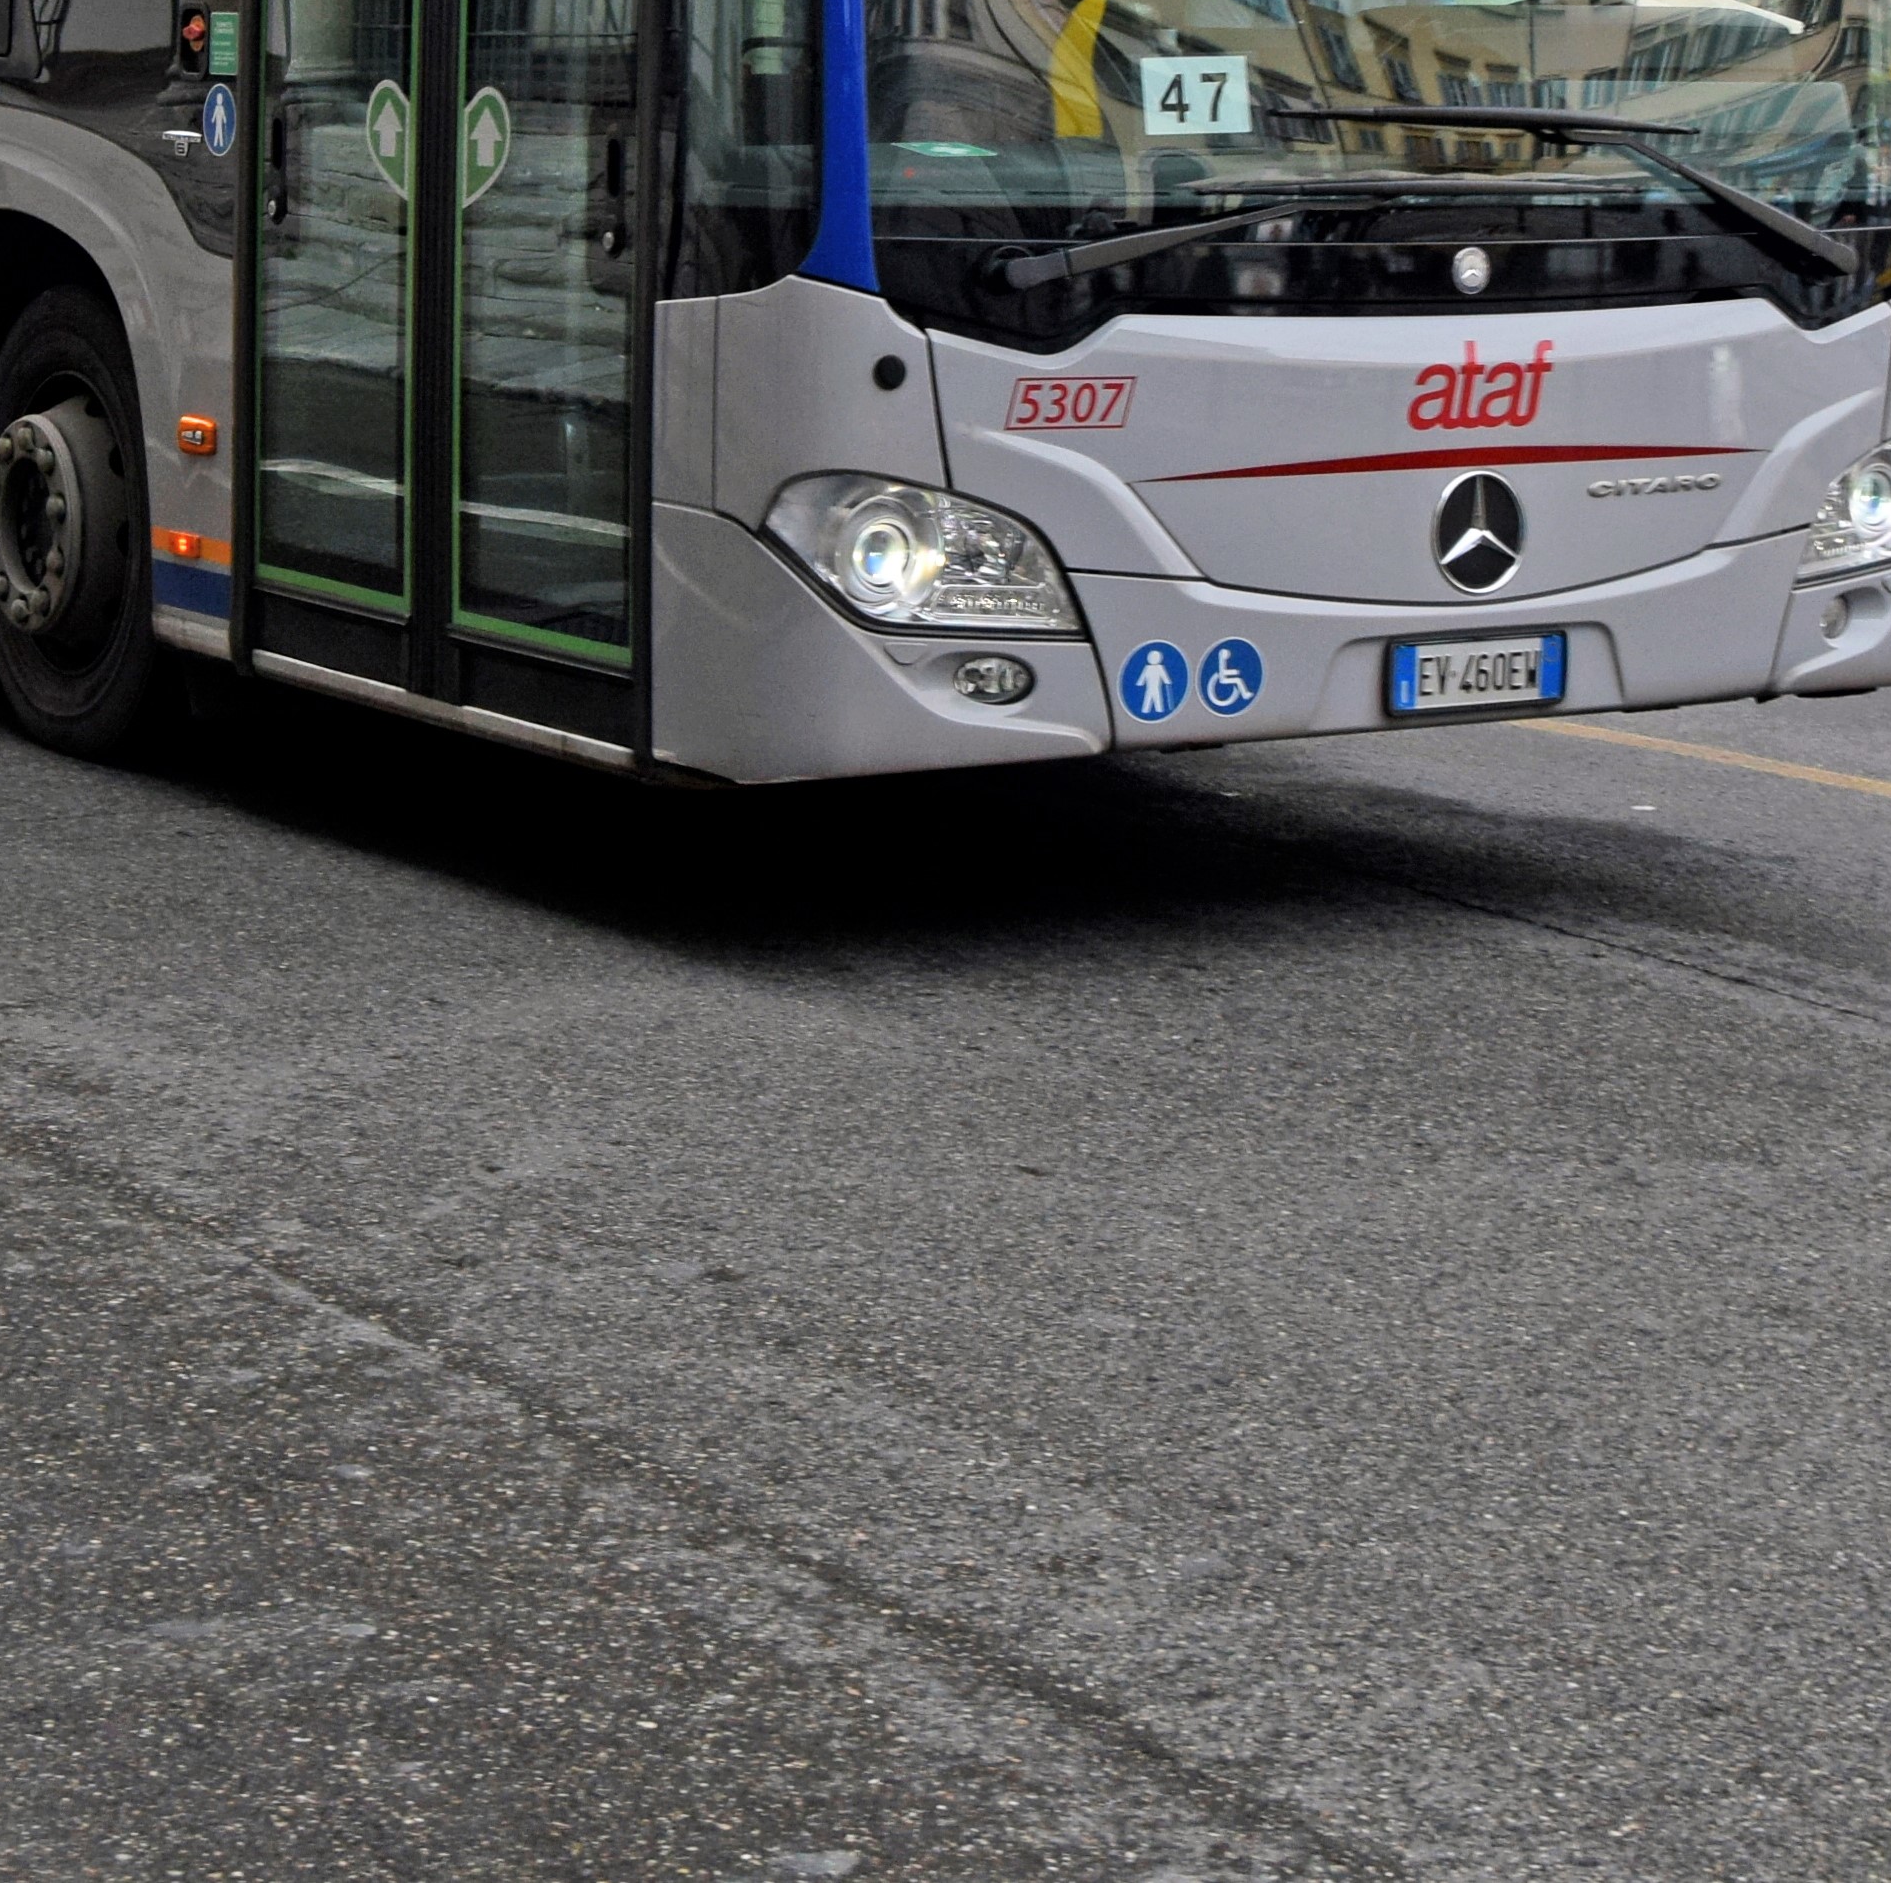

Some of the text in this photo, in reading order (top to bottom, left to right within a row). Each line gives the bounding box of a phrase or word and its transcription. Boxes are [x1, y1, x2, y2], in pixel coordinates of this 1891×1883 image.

[1160, 72, 1228, 124] 47
[1015, 382, 1126, 425] 5307
[1407, 339, 1554, 431] ataf
[1586, 472, 1722, 499] CITARO
